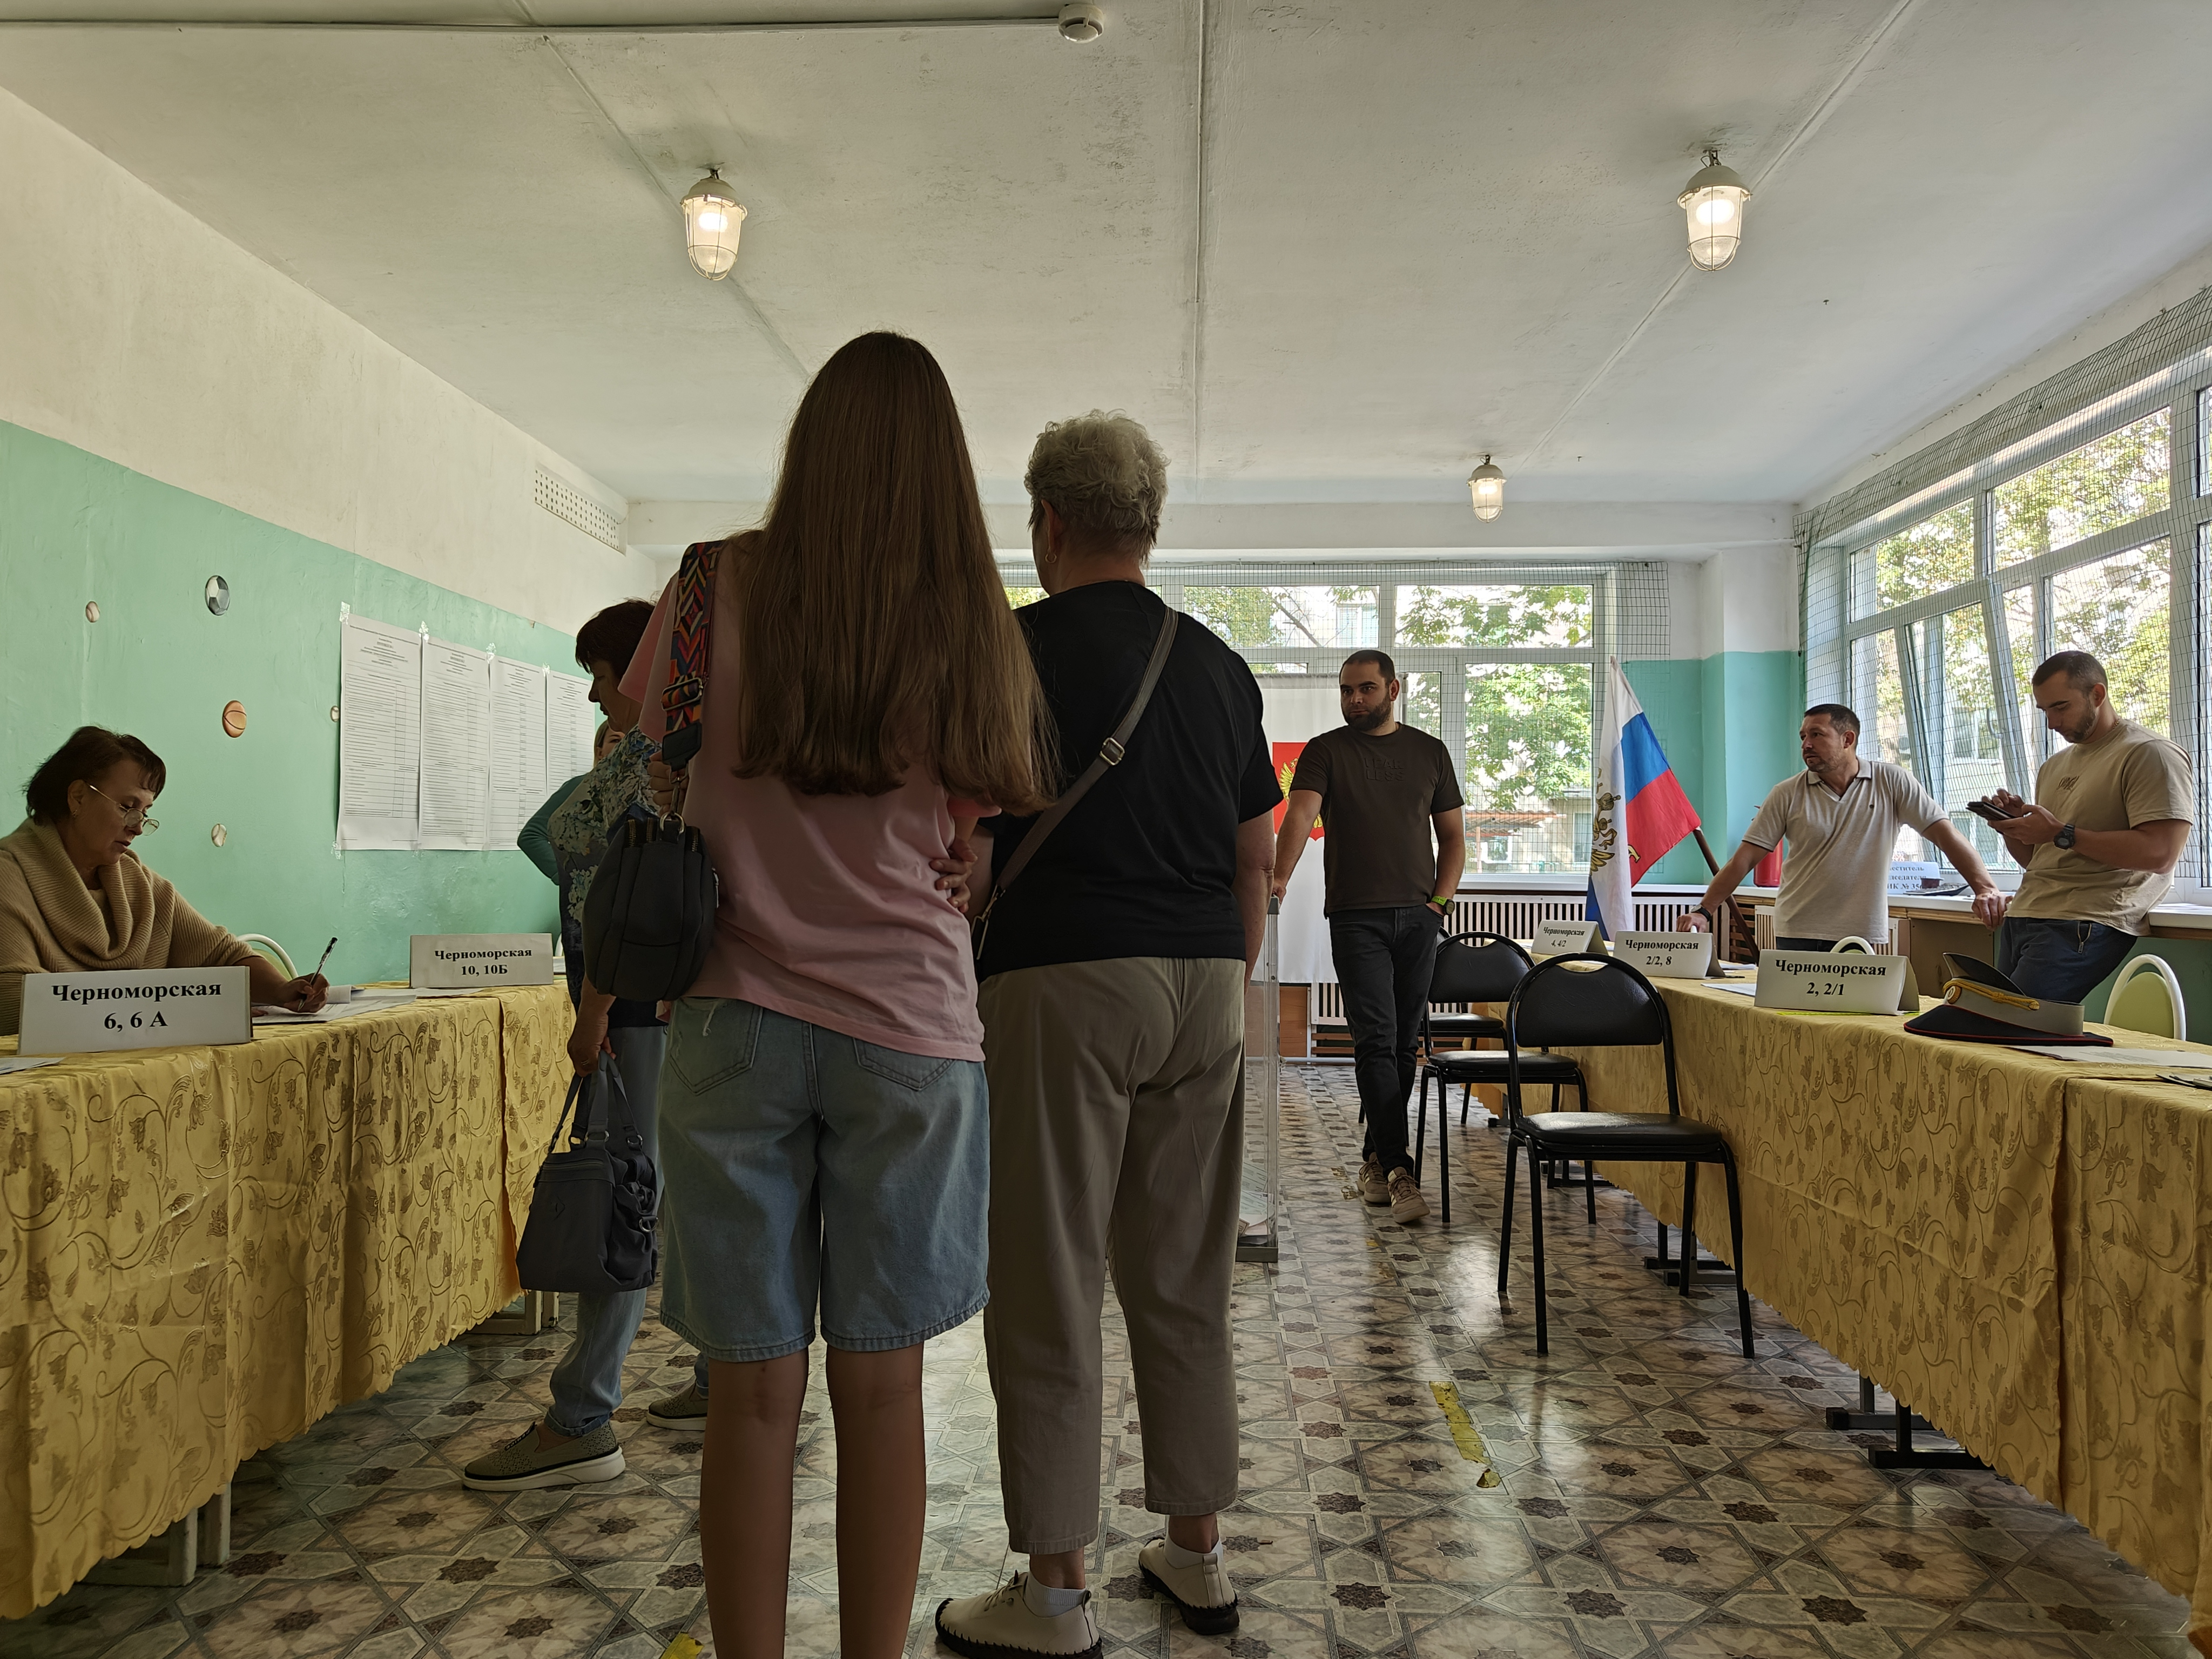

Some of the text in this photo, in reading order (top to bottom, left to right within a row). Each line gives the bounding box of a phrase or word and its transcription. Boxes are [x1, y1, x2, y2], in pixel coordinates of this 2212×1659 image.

[1543, 926, 1585, 937] Черноморская
[1626, 939, 1699, 952] Черноморская
[435, 949, 532, 961] Черноморская
[1646, 956, 1672, 967] 2/2, 8
[462, 965, 508, 976] 10, 10Б
[1776, 959, 1886, 977] Черноморская
[51, 984, 221, 1005] Черноморская
[1806, 982, 1844, 996] 2, 2/1
[104, 1010, 168, 1032] 6, 6 А
